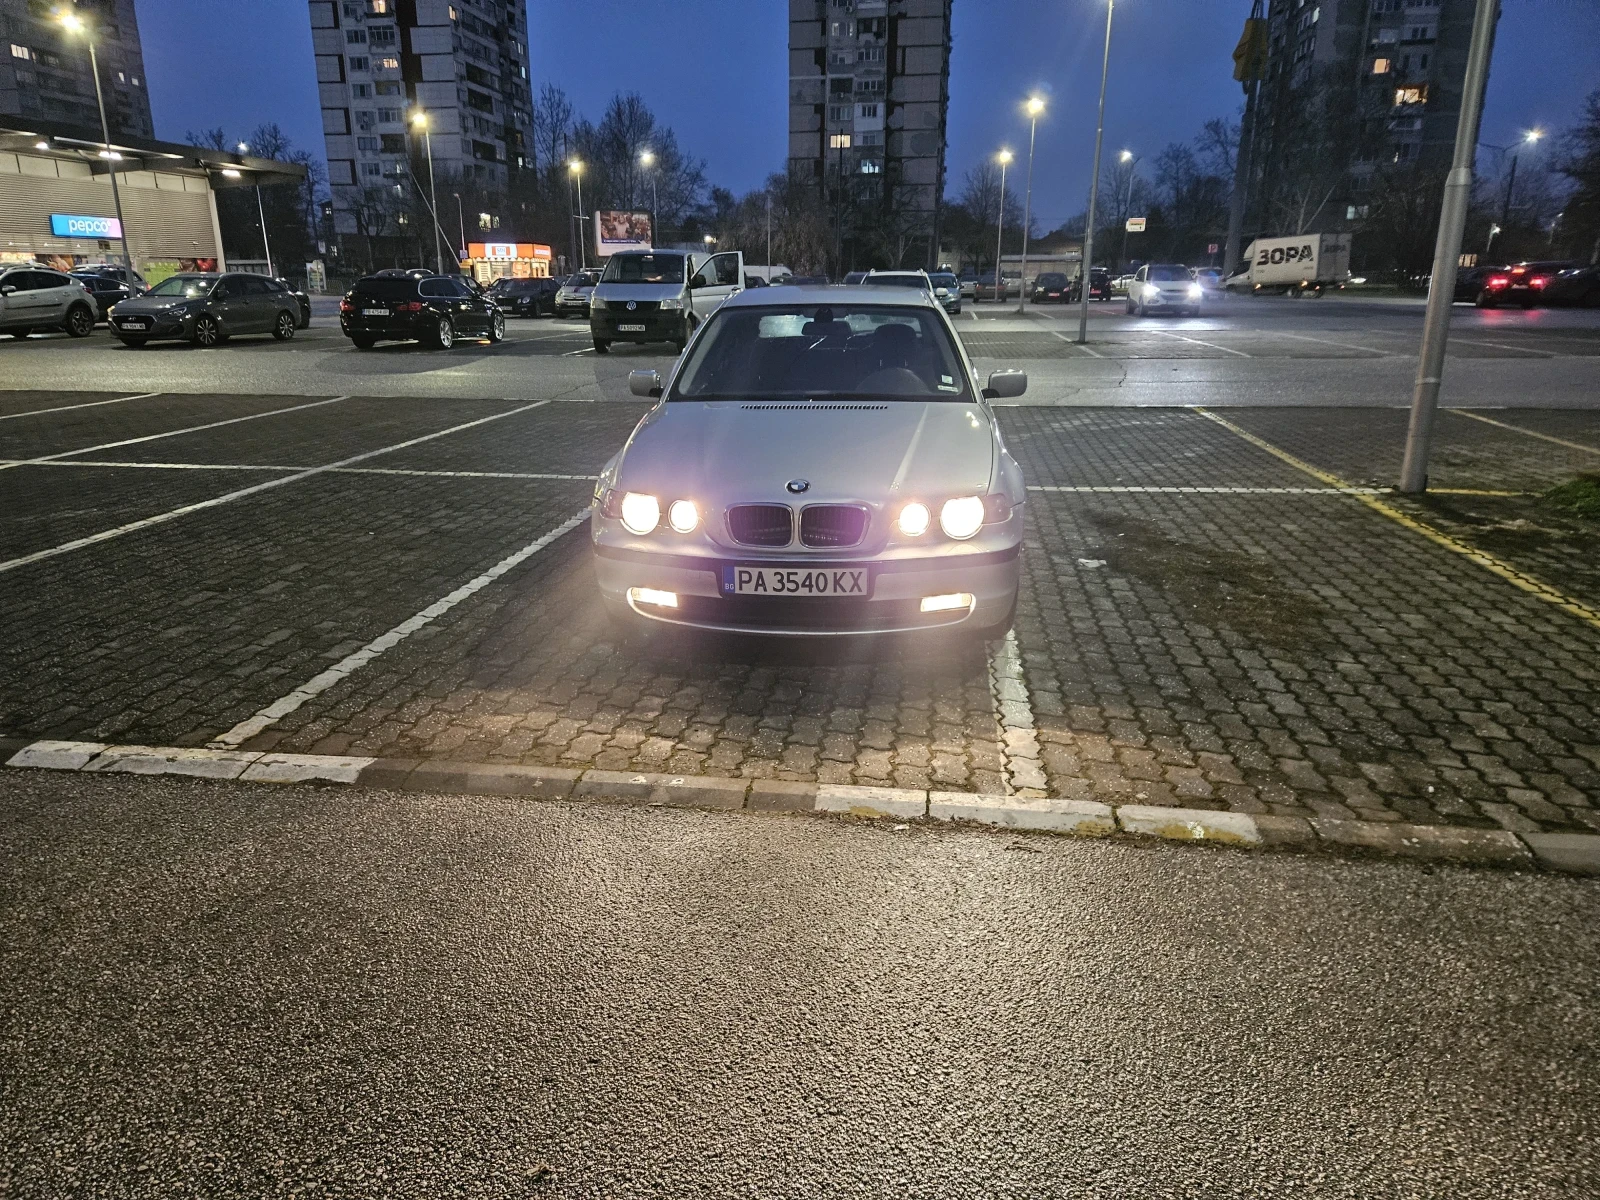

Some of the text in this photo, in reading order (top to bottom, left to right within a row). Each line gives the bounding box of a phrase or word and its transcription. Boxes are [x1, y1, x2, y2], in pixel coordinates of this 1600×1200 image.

[69, 219, 109, 234] pepco
[738, 570, 862, 593] PA 3540 KX
